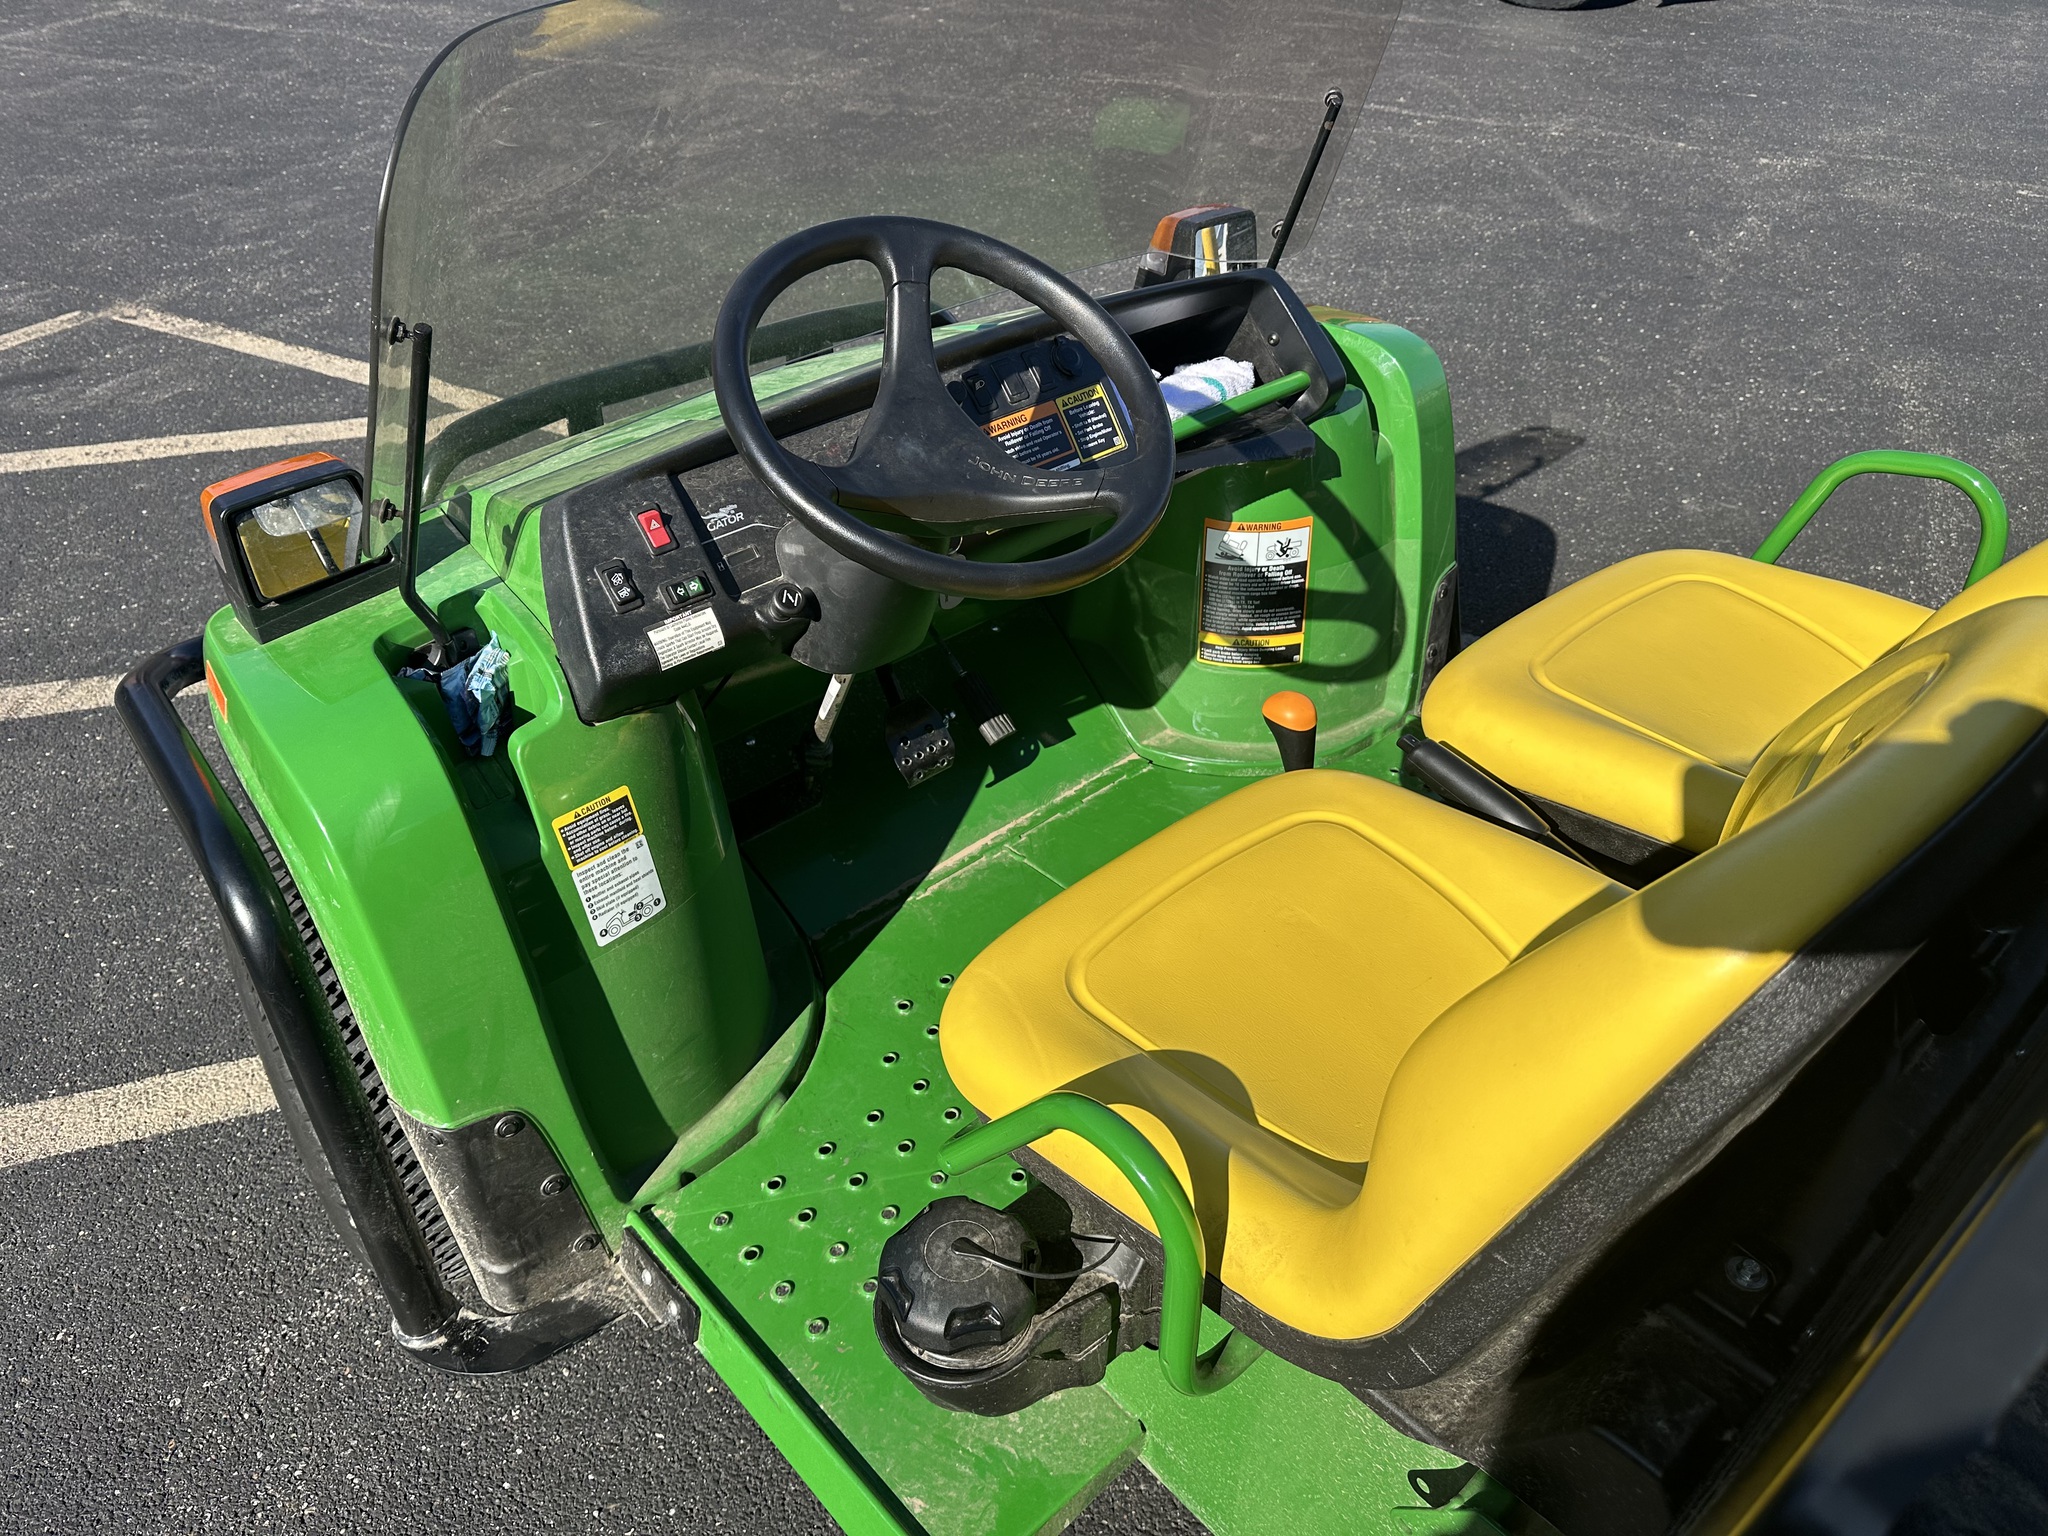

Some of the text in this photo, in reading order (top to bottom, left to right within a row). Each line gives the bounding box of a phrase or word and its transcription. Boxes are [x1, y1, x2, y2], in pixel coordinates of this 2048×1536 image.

[1068, 388, 1099, 405] CAUTION
[988, 414, 1028, 434] WARNING
[998, 434, 1010, 442] Avoid
[1010, 428, 1024, 438] Injury
[1029, 422, 1042, 430] Death
[1004, 436, 1023, 446] Rollover
[1029, 429, 1044, 438] Falling
[968, 456, 1084, 487] JOHN DEERE
[707, 512, 744, 531] GATOR
[664, 610, 692, 624] IMPORTANT
[581, 796, 610, 814] CAUTION
[612, 804, 624, 813] leaves
[577, 812, 599, 826] equipment
[588, 822, 600, 830] debris
[571, 840, 586, 849] Inspect
[587, 831, 603, 841] machine
[574, 832, 590, 843] moving
[591, 841, 604, 850] engine
[577, 852, 593, 862] machine
[608, 838, 621, 846] before
[577, 865, 595, 878] Inspect
[607, 852, 620, 861] clean
[579, 873, 594, 883] entire
[595, 861, 616, 875] machine
[592, 871, 610, 884] special
[611, 859, 632, 873] attention
[584, 872, 622, 895] these locations:
